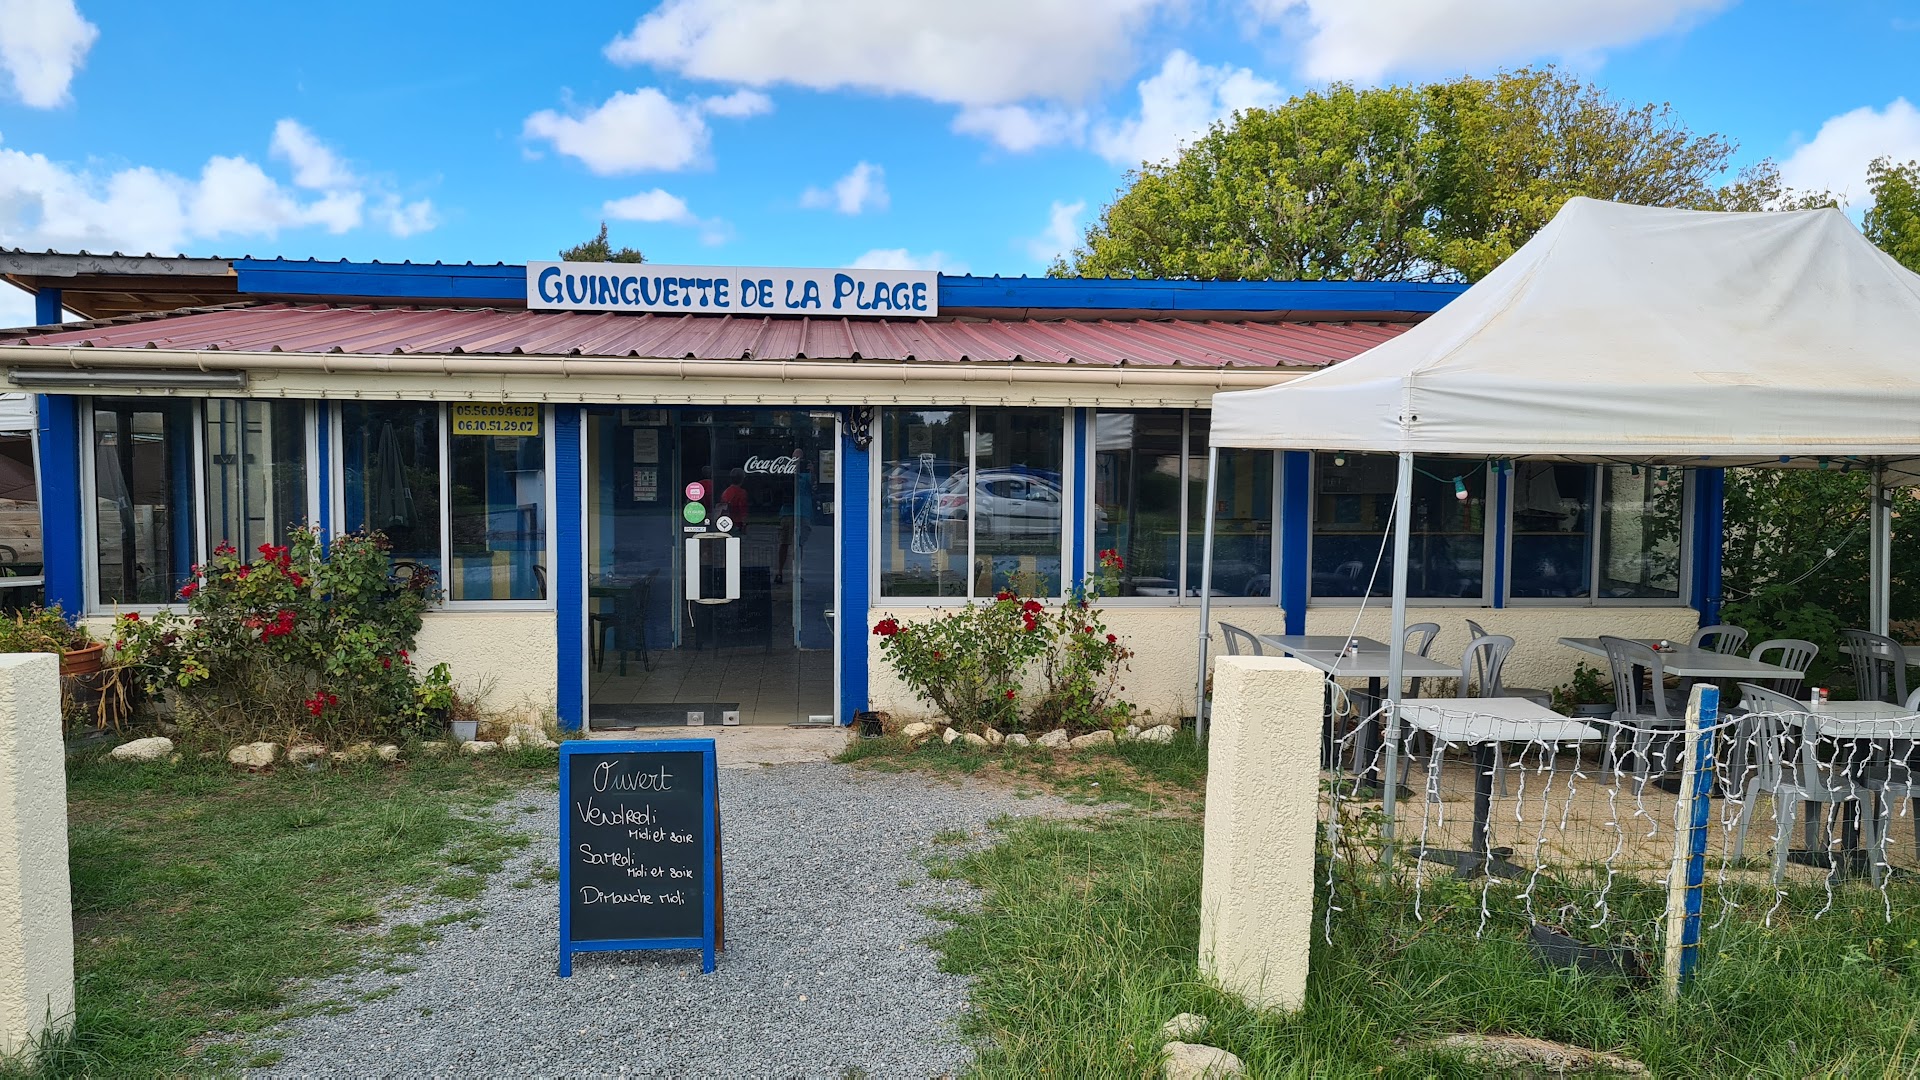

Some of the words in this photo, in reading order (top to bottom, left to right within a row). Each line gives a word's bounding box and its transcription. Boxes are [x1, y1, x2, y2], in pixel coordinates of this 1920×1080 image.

[537, 266, 731, 308] GUINGUETTE
[740, 278, 774, 308] DE
[785, 279, 822, 309] LA
[832, 273, 928, 312] PLAGE
[456, 406, 535, 417] 05.56.09.46.12
[458, 420, 534, 432] 06.10.51.29.07
[593, 760, 674, 792] Ouvert
[652, 826, 667, 843] et
[650, 866, 665, 878] et
[580, 885, 654, 905] Dimanche
